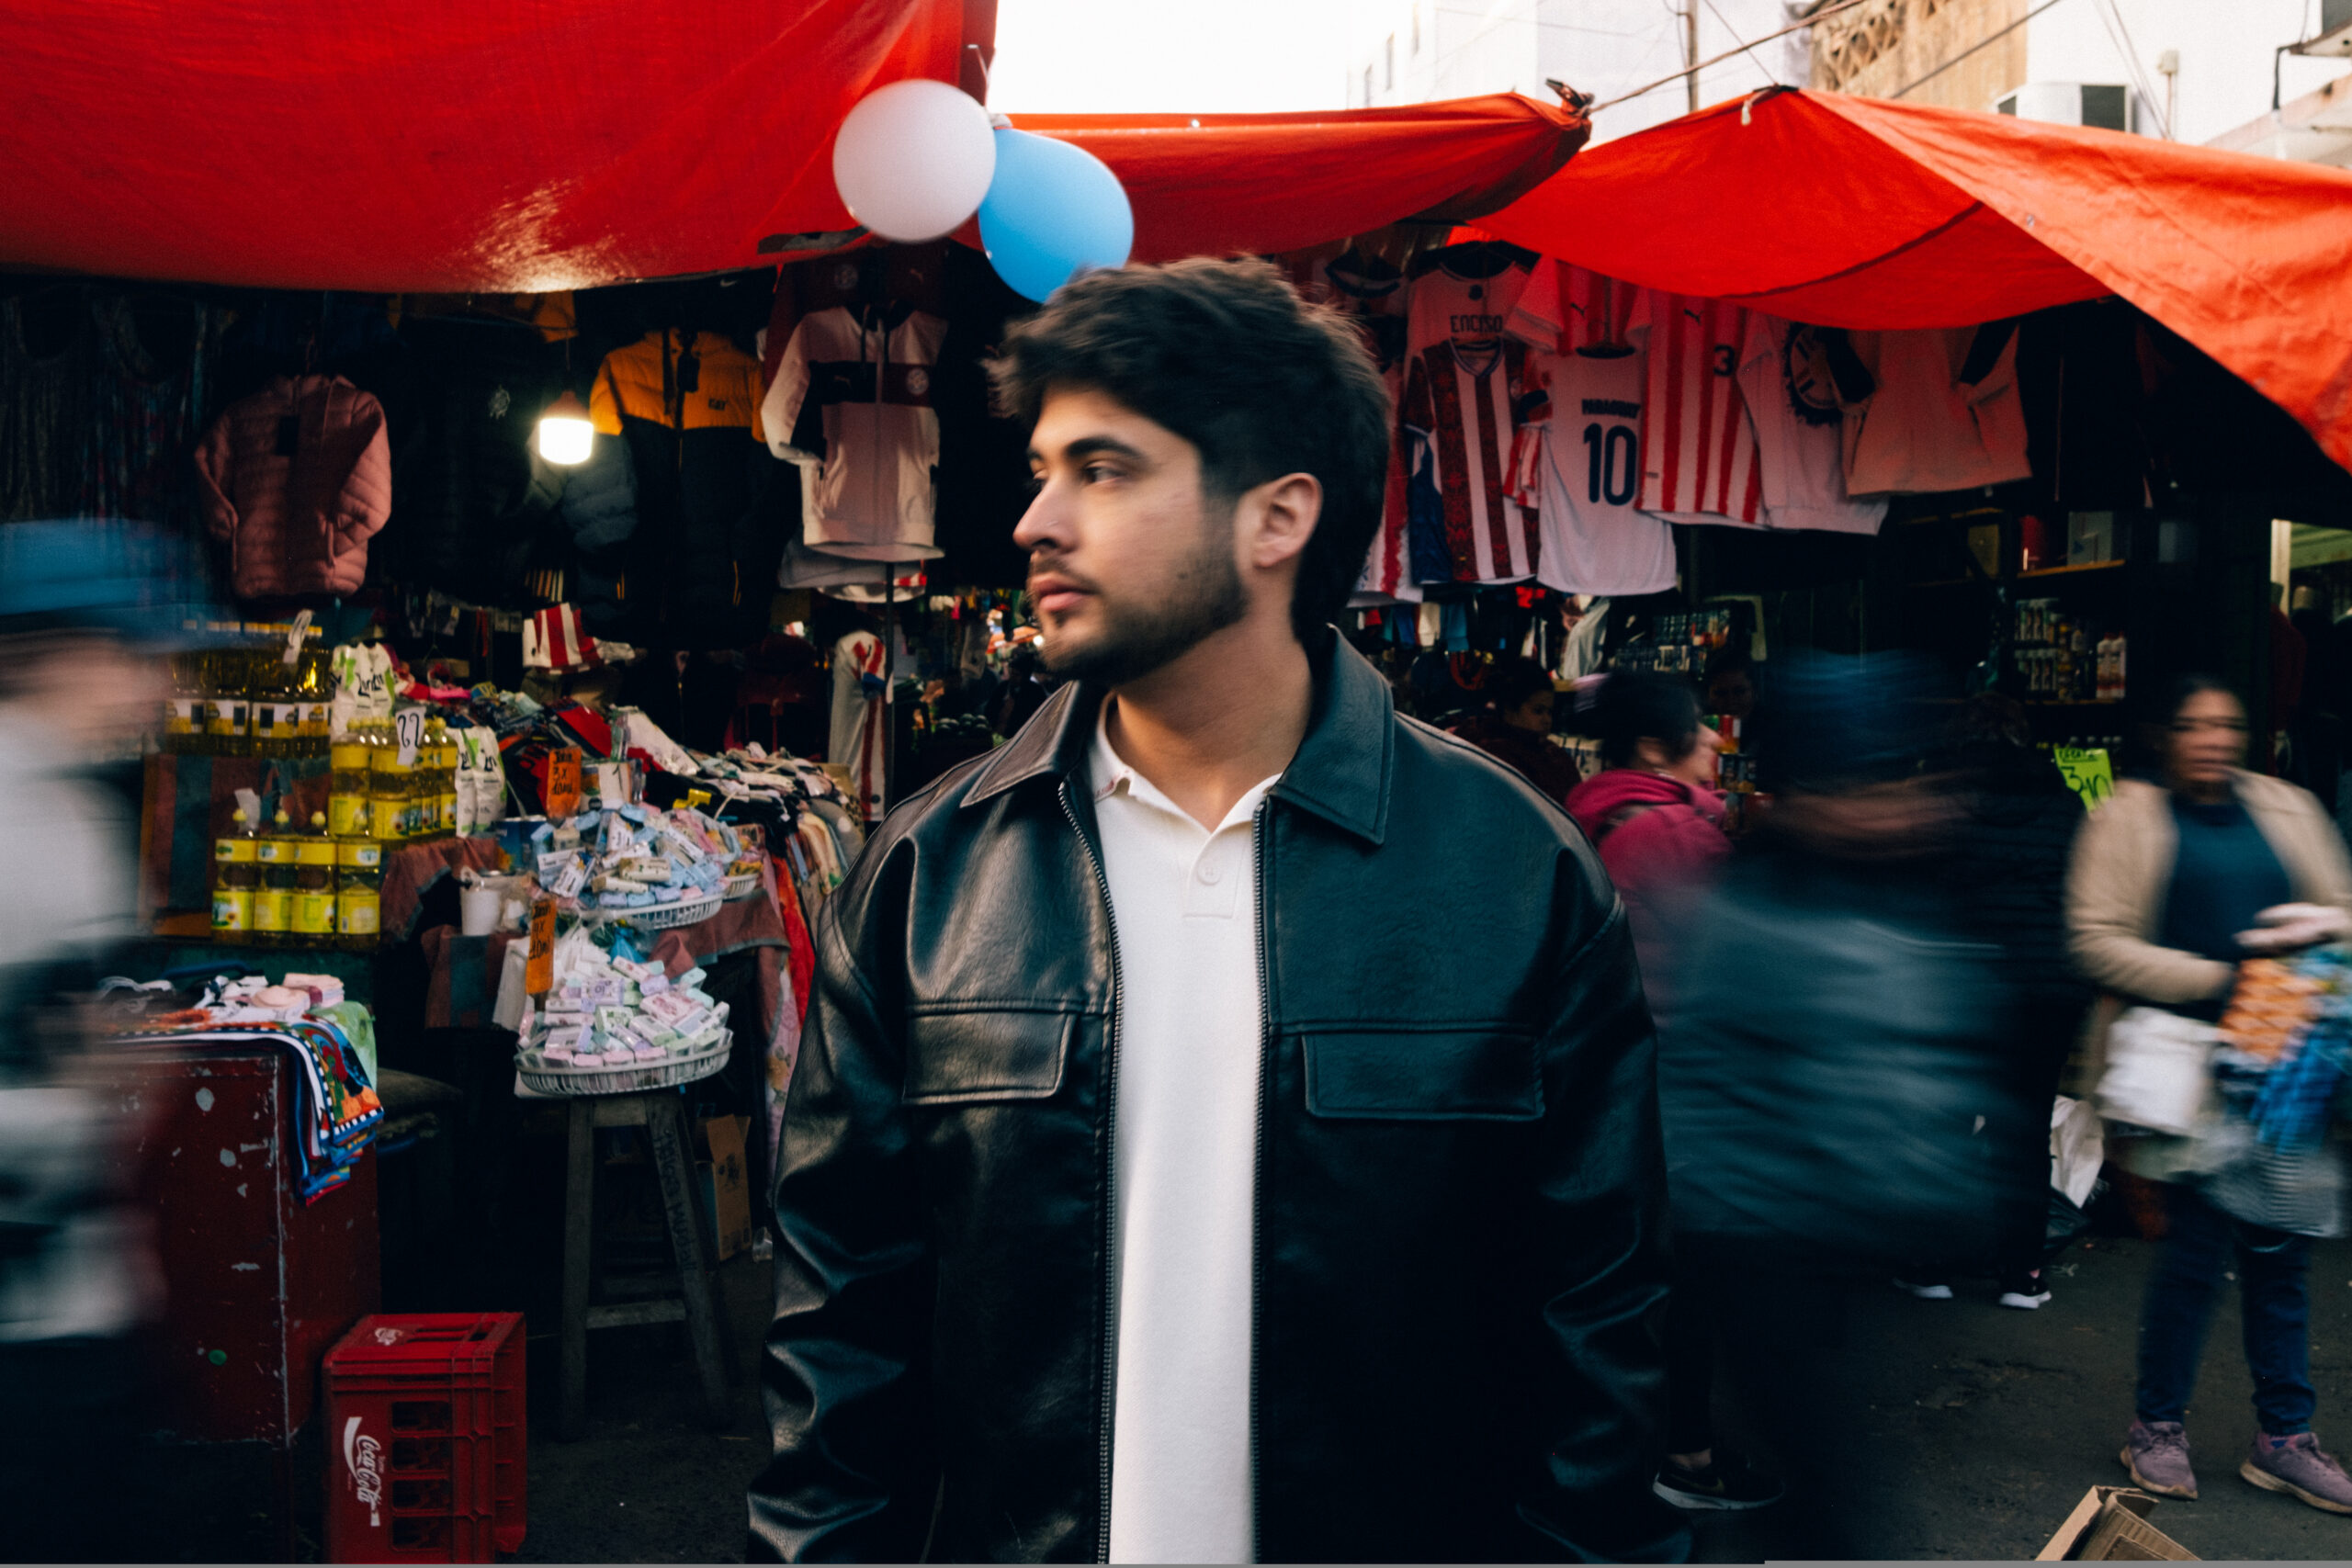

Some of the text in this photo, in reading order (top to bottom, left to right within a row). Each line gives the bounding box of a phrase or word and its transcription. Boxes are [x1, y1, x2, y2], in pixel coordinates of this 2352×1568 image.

[1450, 314, 1503, 333] ENCISO
[1713, 344, 1736, 378] 3
[1583, 423, 1637, 506] 10
[356, 1435, 382, 1506] Coca-Cola
